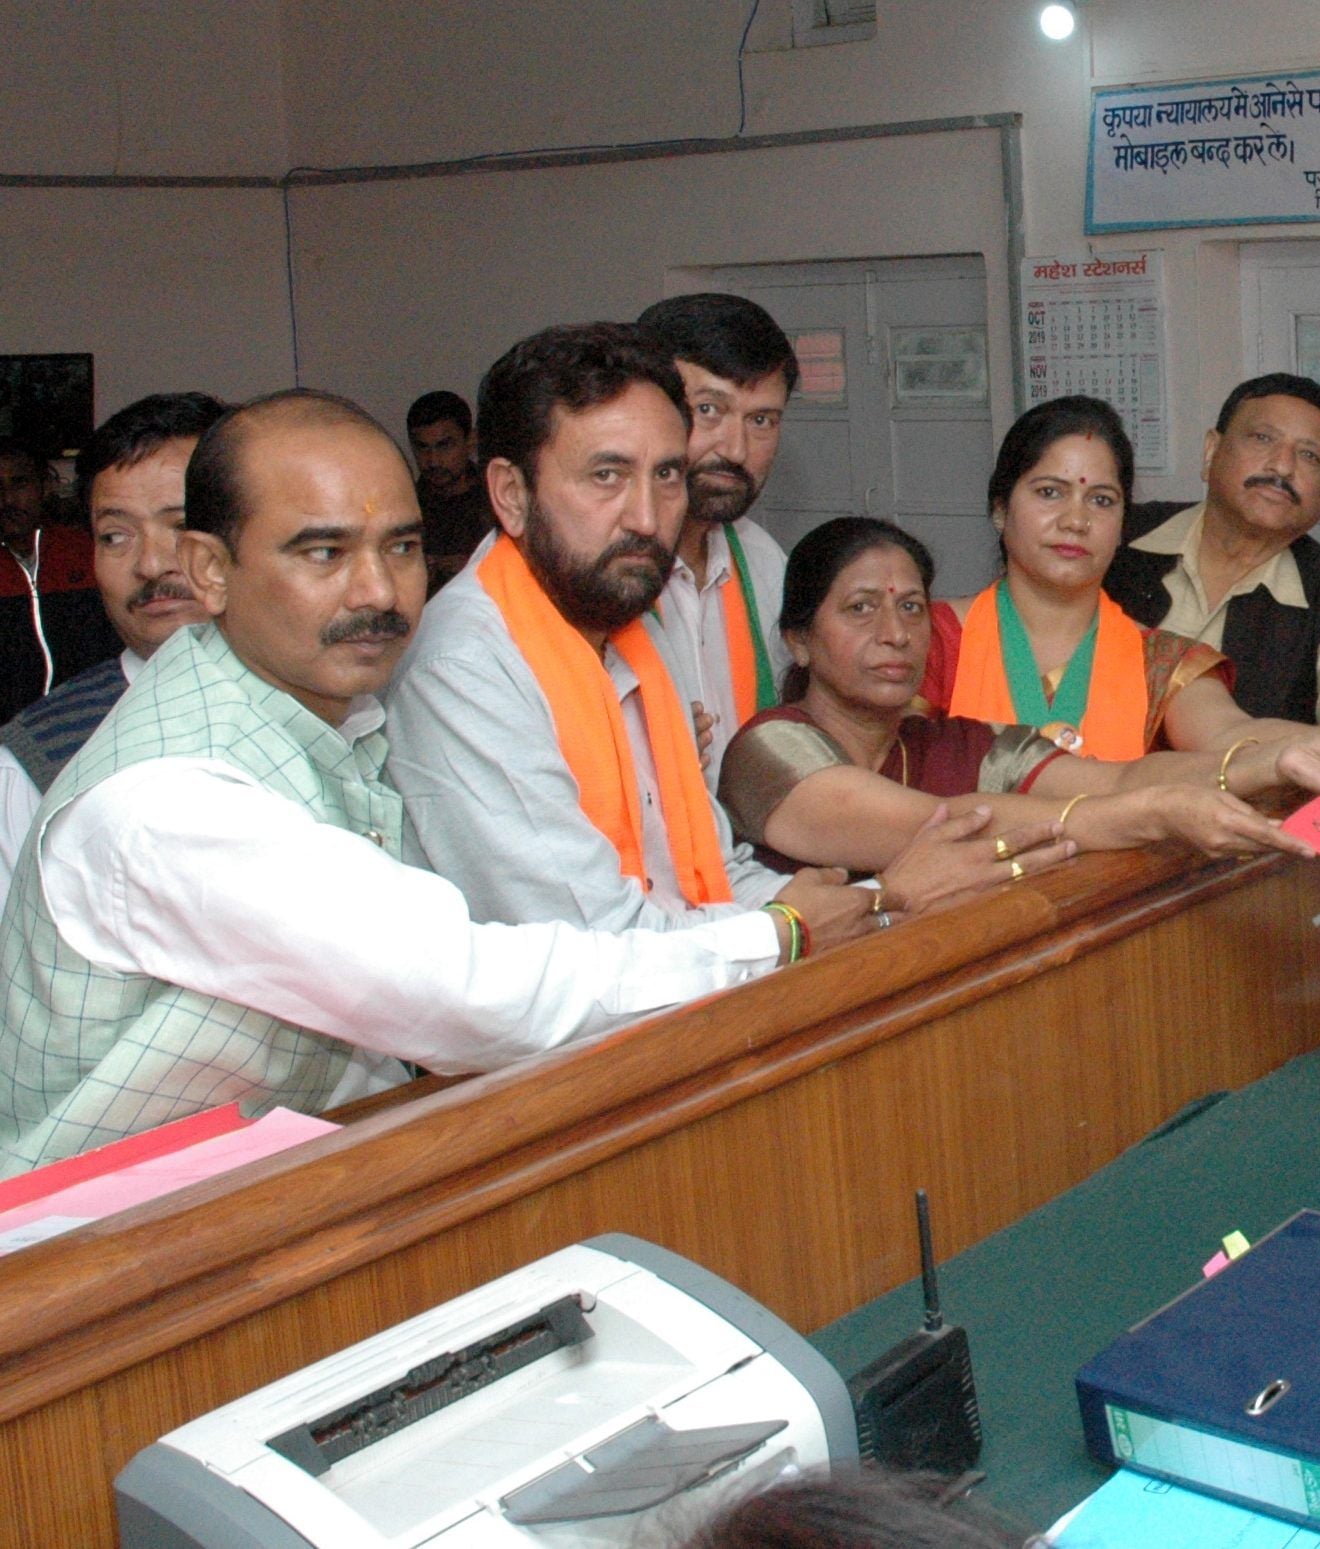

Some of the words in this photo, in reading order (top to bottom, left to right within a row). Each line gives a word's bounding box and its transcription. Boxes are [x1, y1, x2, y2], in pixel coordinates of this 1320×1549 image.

[1102, 104, 1153, 137] कृपया
[1113, 133, 1188, 174] मोबाइल
[1188, 138, 1231, 168] बन्द
[1033, 259, 1077, 280] महेश
[1082, 254, 1147, 278] स्टेशनर्स
[1028, 309, 1046, 325] OCT
[1028, 331, 1046, 345] 2019
[1030, 364, 1048, 380] NOV
[1031, 384, 1048, 399] 2019
